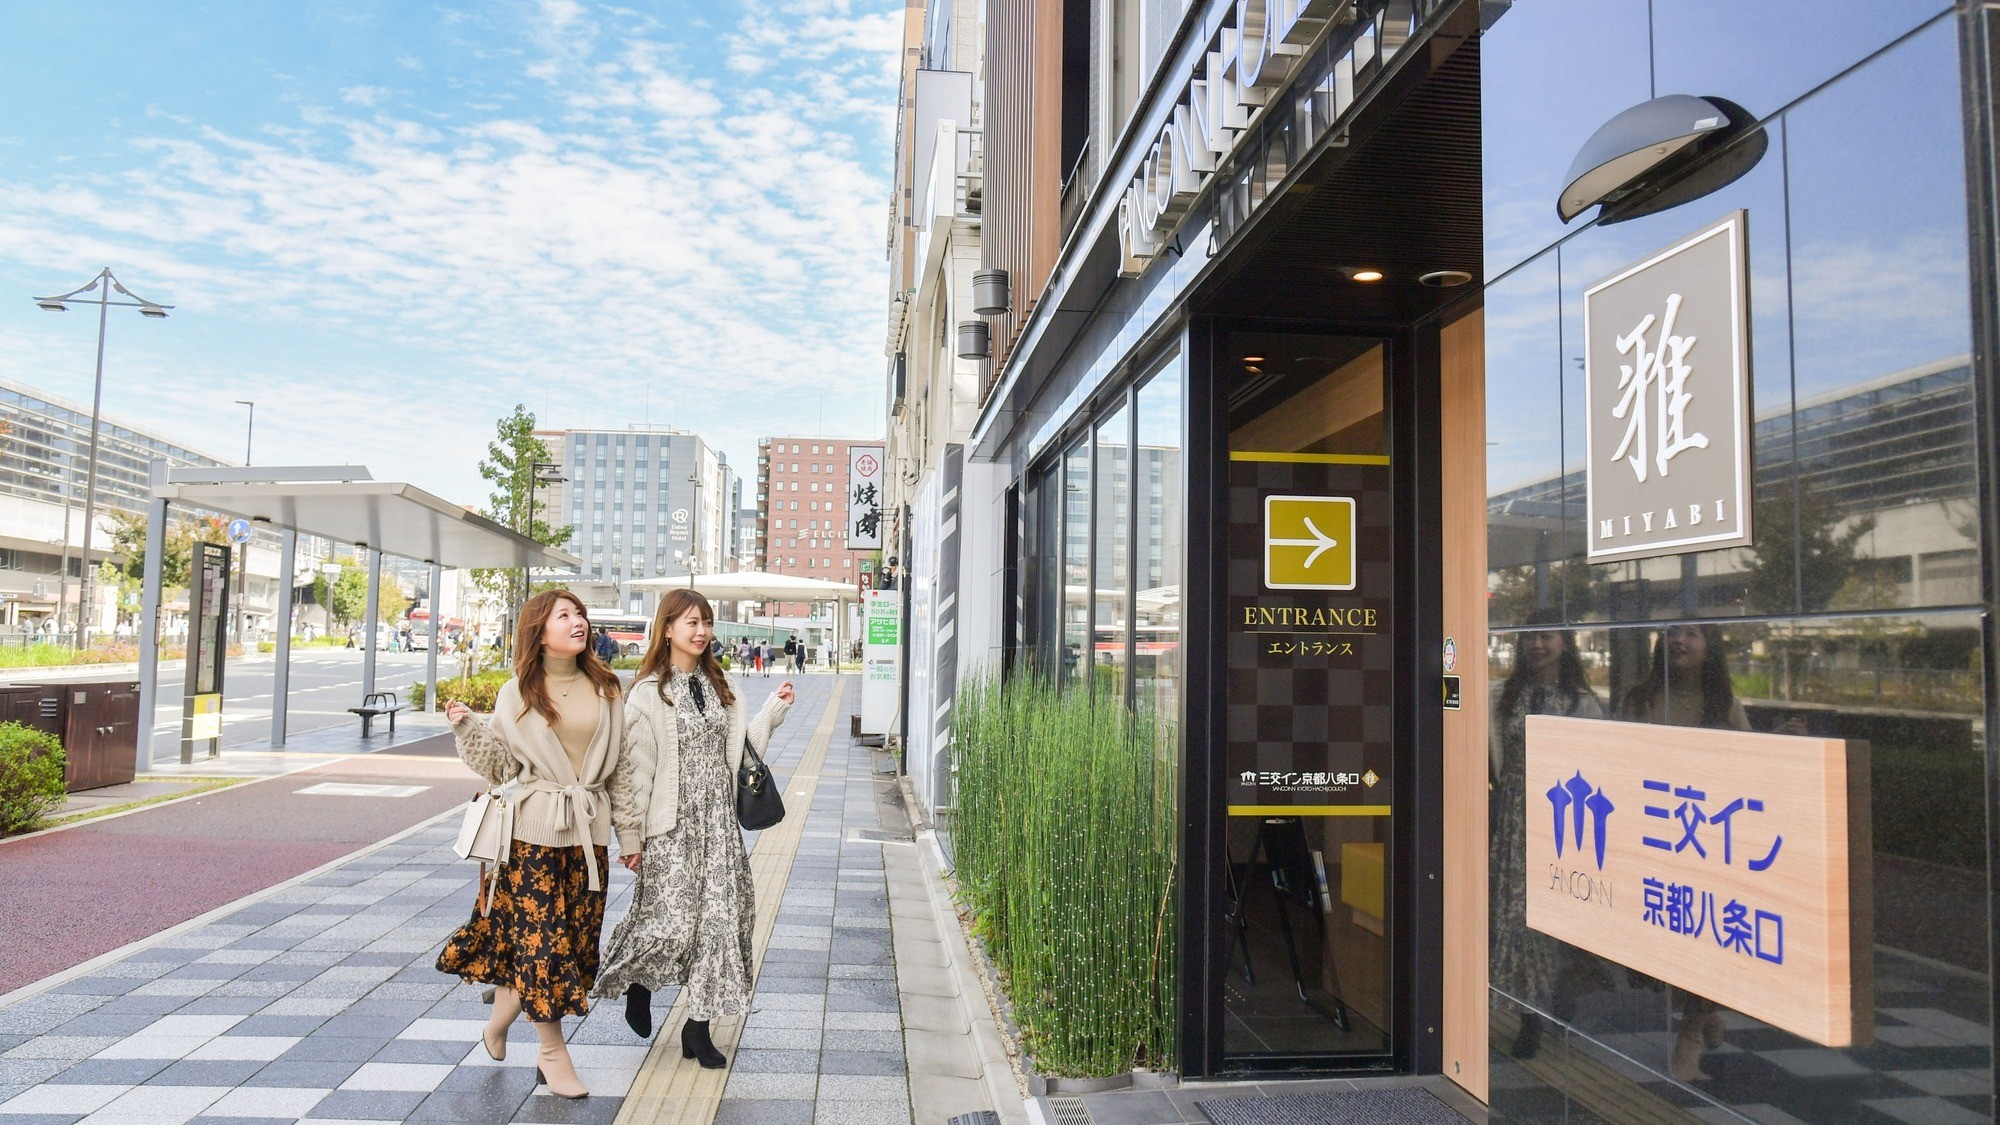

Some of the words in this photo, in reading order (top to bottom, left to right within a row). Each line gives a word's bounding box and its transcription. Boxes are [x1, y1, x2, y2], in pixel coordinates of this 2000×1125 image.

[1610, 293, 1709, 483] 雅
[853, 481, 881, 540] 焼肉
[1600, 499, 1725, 539] MIYABI
[1243, 606, 1377, 627] ENTRANCE
[1267, 640, 1353, 656] エントランス
[1259, 771, 1360, 785] 三交イン京都八条口
[1642, 779, 1783, 872] 三交イン
[1549, 863, 1613, 908] SANCOINN
[1642, 876, 1784, 966] 京都八条口
